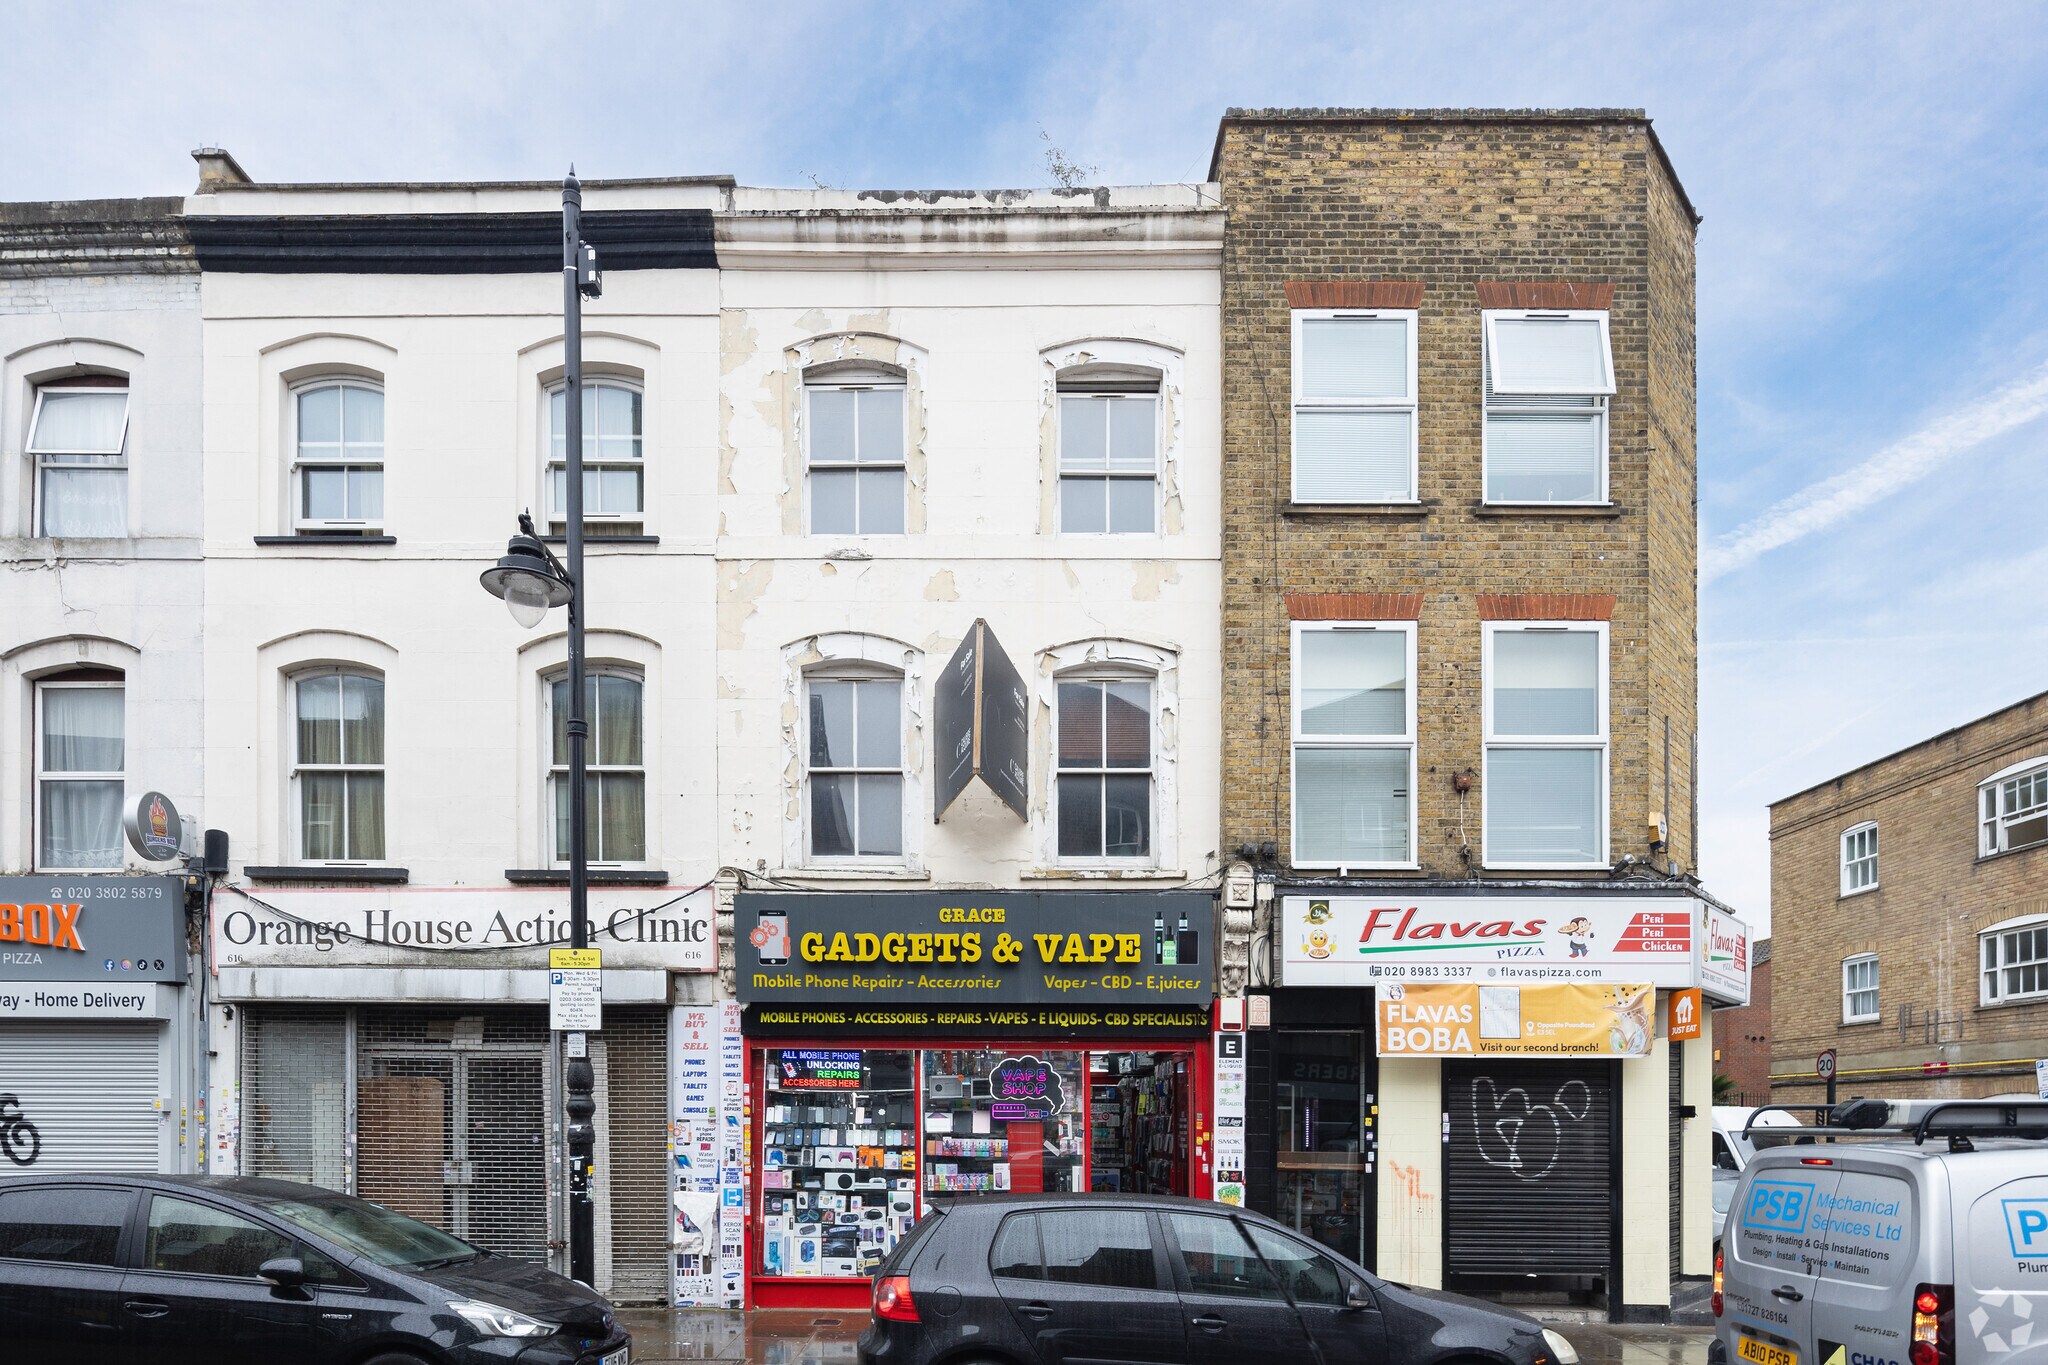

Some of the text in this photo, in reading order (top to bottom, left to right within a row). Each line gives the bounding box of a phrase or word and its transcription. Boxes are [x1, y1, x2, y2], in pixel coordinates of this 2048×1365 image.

[68, 887, 162, 899] 020 3802 5879
[939, 907, 1006, 924] GRACE
[0, 903, 85, 951] BOX
[223, 910, 351, 952] Orange
[362, 909, 473, 945] House
[607, 907, 709, 943] Clinic
[1359, 907, 1548, 944] Flavas
[1710, 918, 1734, 953] Flavas
[800, 931, 1142, 964] GADGETS & VAPE
[1497, 946, 1545, 959] PIZZA
[3, 953, 42, 965] PIZZA
[227, 953, 244, 963] 616
[685, 951, 702, 960] 616
[1384, 966, 1472, 977] 020 8983 3337
[1500, 966, 1602, 979] flavaspizza.com
[553, 974, 561, 984] P
[753, 974, 802, 988] Mobile
[805, 974, 849, 988] Phone
[852, 974, 904, 992] Repairs
[917, 974, 1002, 989] Accessories
[1043, 975, 1087, 992] Vapes
[1101, 975, 1132, 989] CBD
[0, 992, 146, 1011] ay Home Delivery
[688, 1012, 705, 1021] WE
[760, 1012, 800, 1024] MOBILE
[802, 1012, 846, 1024] PHONES
[854, 1012, 928, 1024] ACCESSORIES
[937, 1012, 982, 1024] REPAIRS
[1039, 1013, 1046, 1025] E
[1104, 1013, 1130, 1025] CBD
[1132, 1013, 1208, 1026] SPECIALISTS
[1387, 1004, 1472, 1023] FLAVAS
[692, 1031, 699, 1040] &
[1671, 1024, 1698, 1036] JUST EAT
[683, 1042, 709, 1050] SELL
[1387, 1027, 1473, 1052] BOBA
[1225, 1041, 1236, 1054] E
[1480, 1043, 1503, 1052] Visit
[1523, 1043, 1559, 1052] second
[1561, 1043, 1599, 1052] branch!
[782, 1050, 860, 1060] ALL MOBILE PHONE
[806, 1061, 860, 1070] UNLOCKING
[1819, 1059, 1833, 1072] 20
[817, 1071, 860, 1079] REPAIRS
[1001, 1068, 1047, 1082] VAPE
[782, 1079, 860, 1088] ACCESSORIES HERE
[1002, 1082, 1047, 1095] SHOP
[1750, 1188, 1804, 1222] PSB
[1816, 1193, 1900, 1217] Mechanical
[1811, 1213, 1903, 1241] Services Ltd
[1744, 1229, 1890, 1261] Plumbing, Heating & Gas Installations
[1752, 1246, 1870, 1275] Design Install Service Maintain
[1743, 1341, 1791, 1365] AB10 PSB
